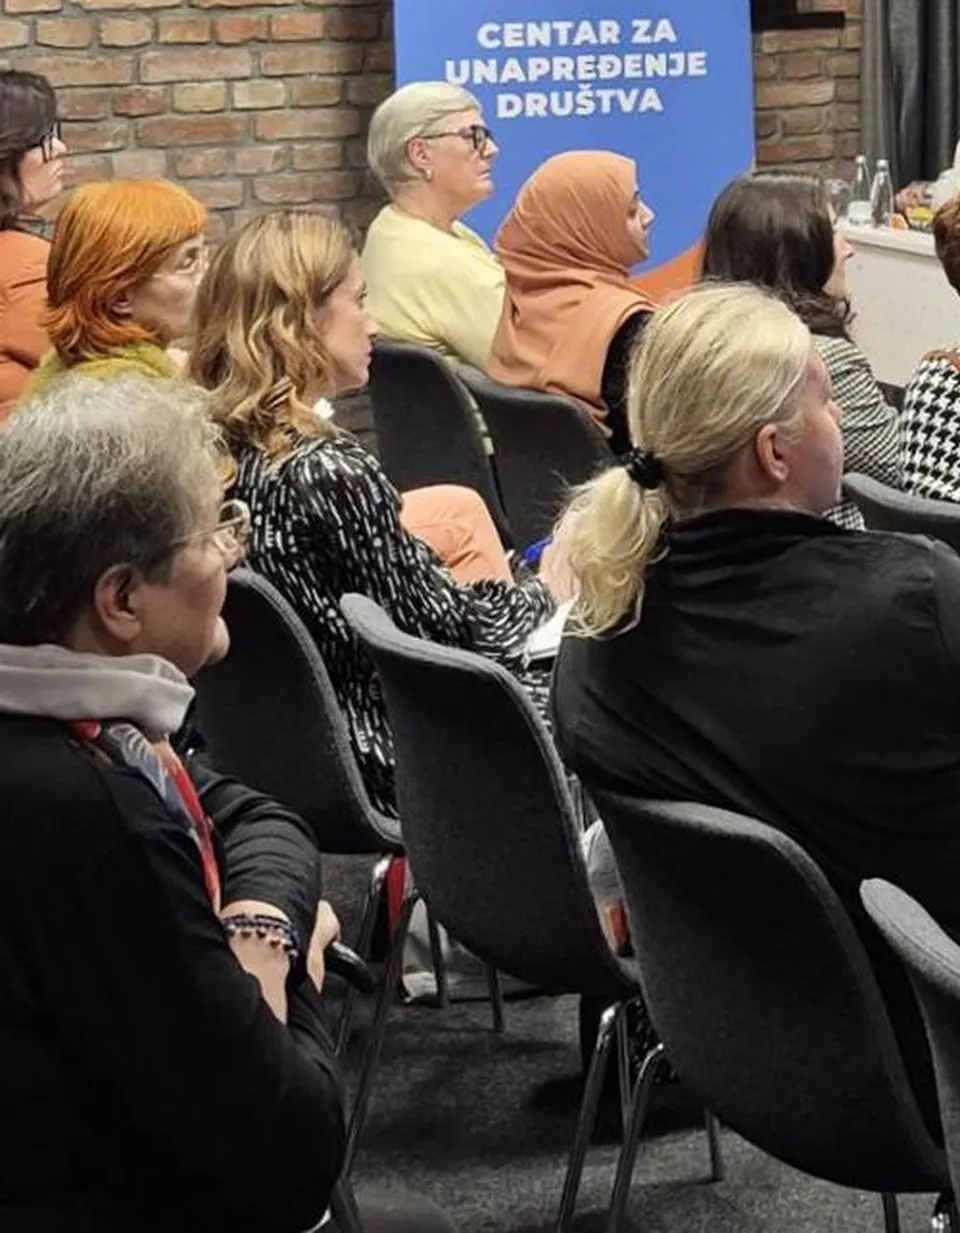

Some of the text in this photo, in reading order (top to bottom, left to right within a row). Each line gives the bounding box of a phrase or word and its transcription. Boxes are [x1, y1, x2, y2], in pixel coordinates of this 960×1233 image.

[477, 18, 677, 50] CENTAR ZA
[444, 51, 708, 85] UNAPREĐENJE
[496, 83, 664, 118] DRUŠTVA
